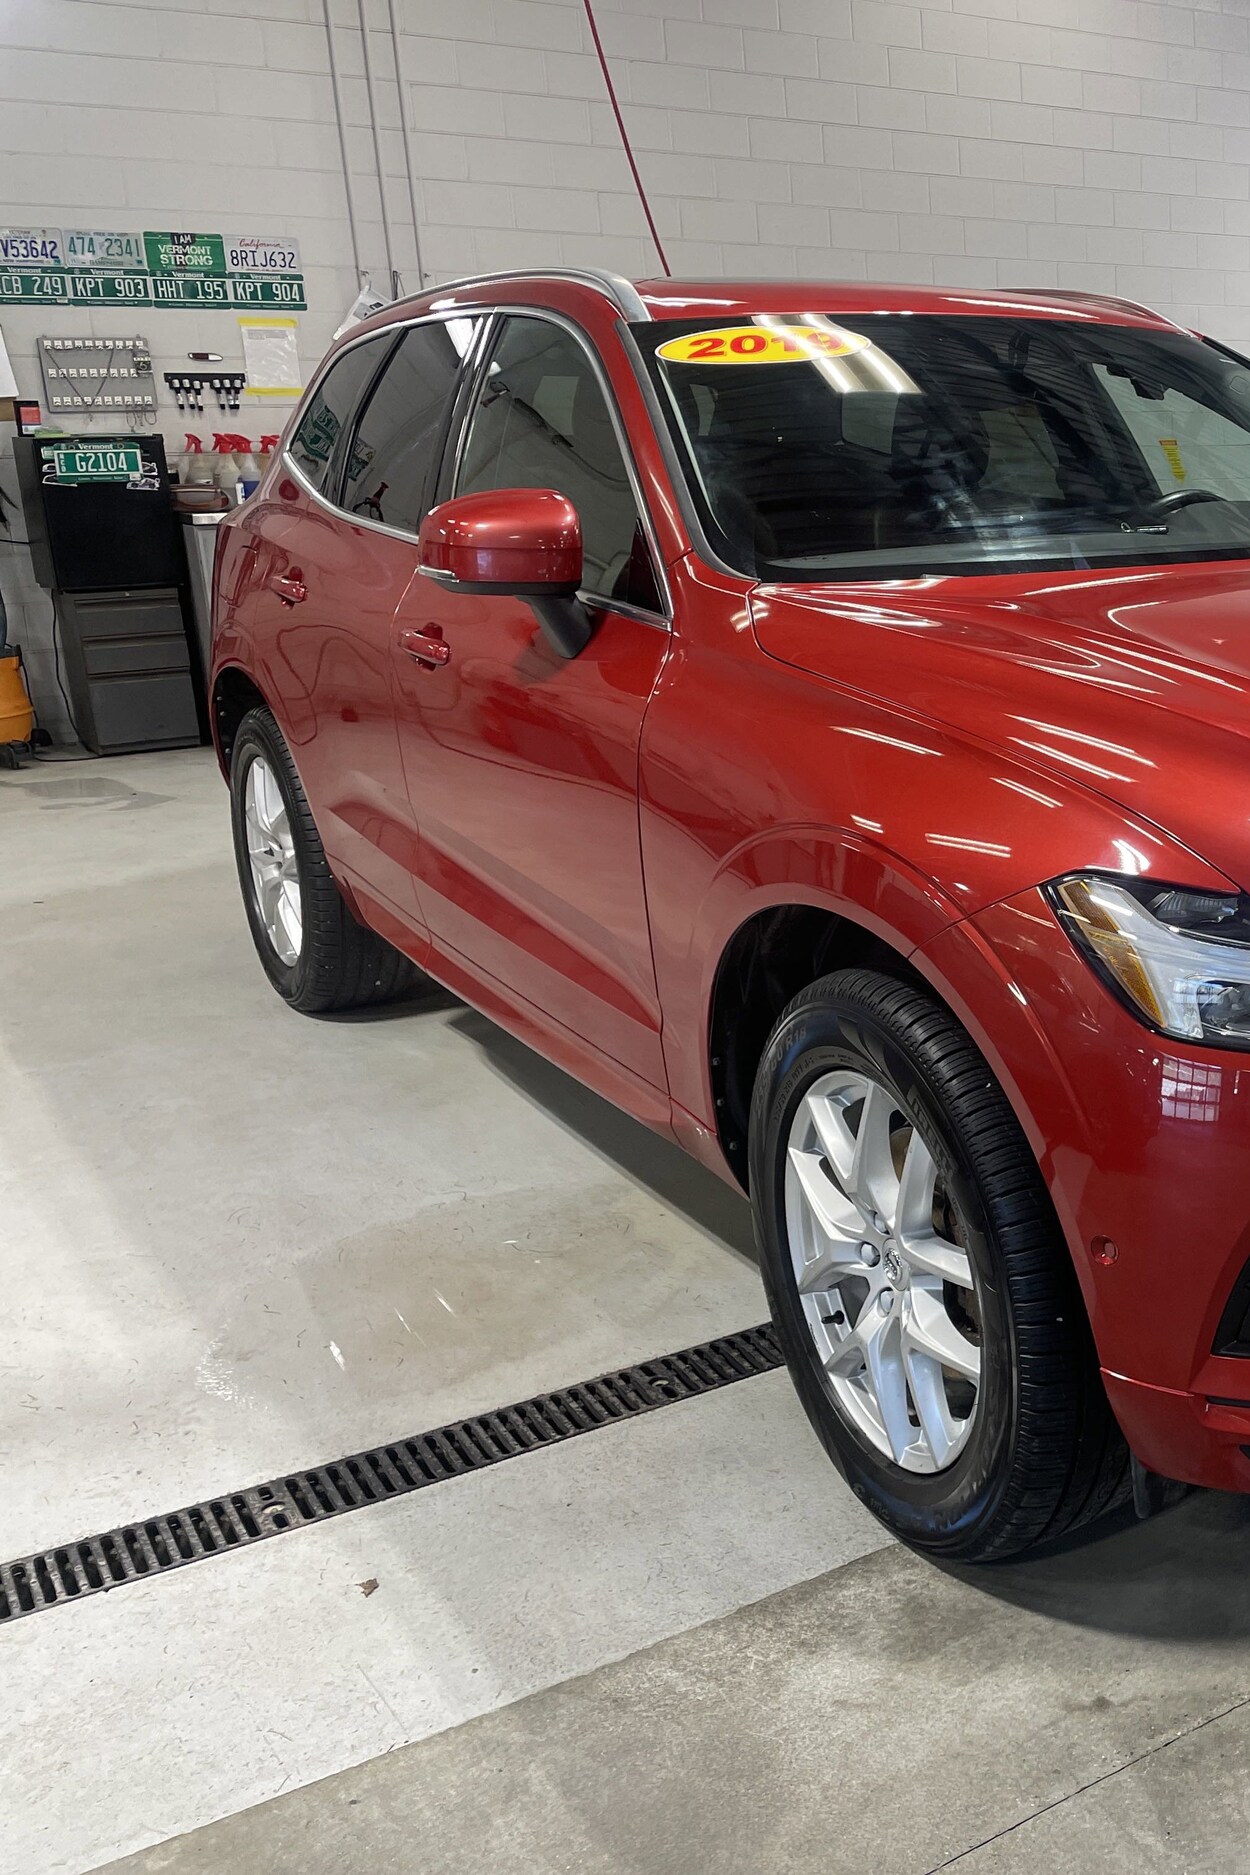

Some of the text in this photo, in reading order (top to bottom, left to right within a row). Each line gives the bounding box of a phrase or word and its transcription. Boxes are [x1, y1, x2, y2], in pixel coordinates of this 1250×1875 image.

[180, 234, 192, 244] AM
[239, 238, 284, 249] California
[158, 244, 211, 255] VERMONT
[160, 254, 213, 266] STRONG
[231, 249, 296, 269] 8RIJ632
[7, 266, 42, 274] Vermont
[90, 268, 125, 276] Vermont
[250, 273, 281, 281] Vermont
[0, 276, 63, 295] CB 249
[75, 277, 145, 298] KPT 903
[157, 280, 224, 300] HHT 195
[236, 282, 300, 301] KPT 904
[75, 452, 127, 472] G2104
